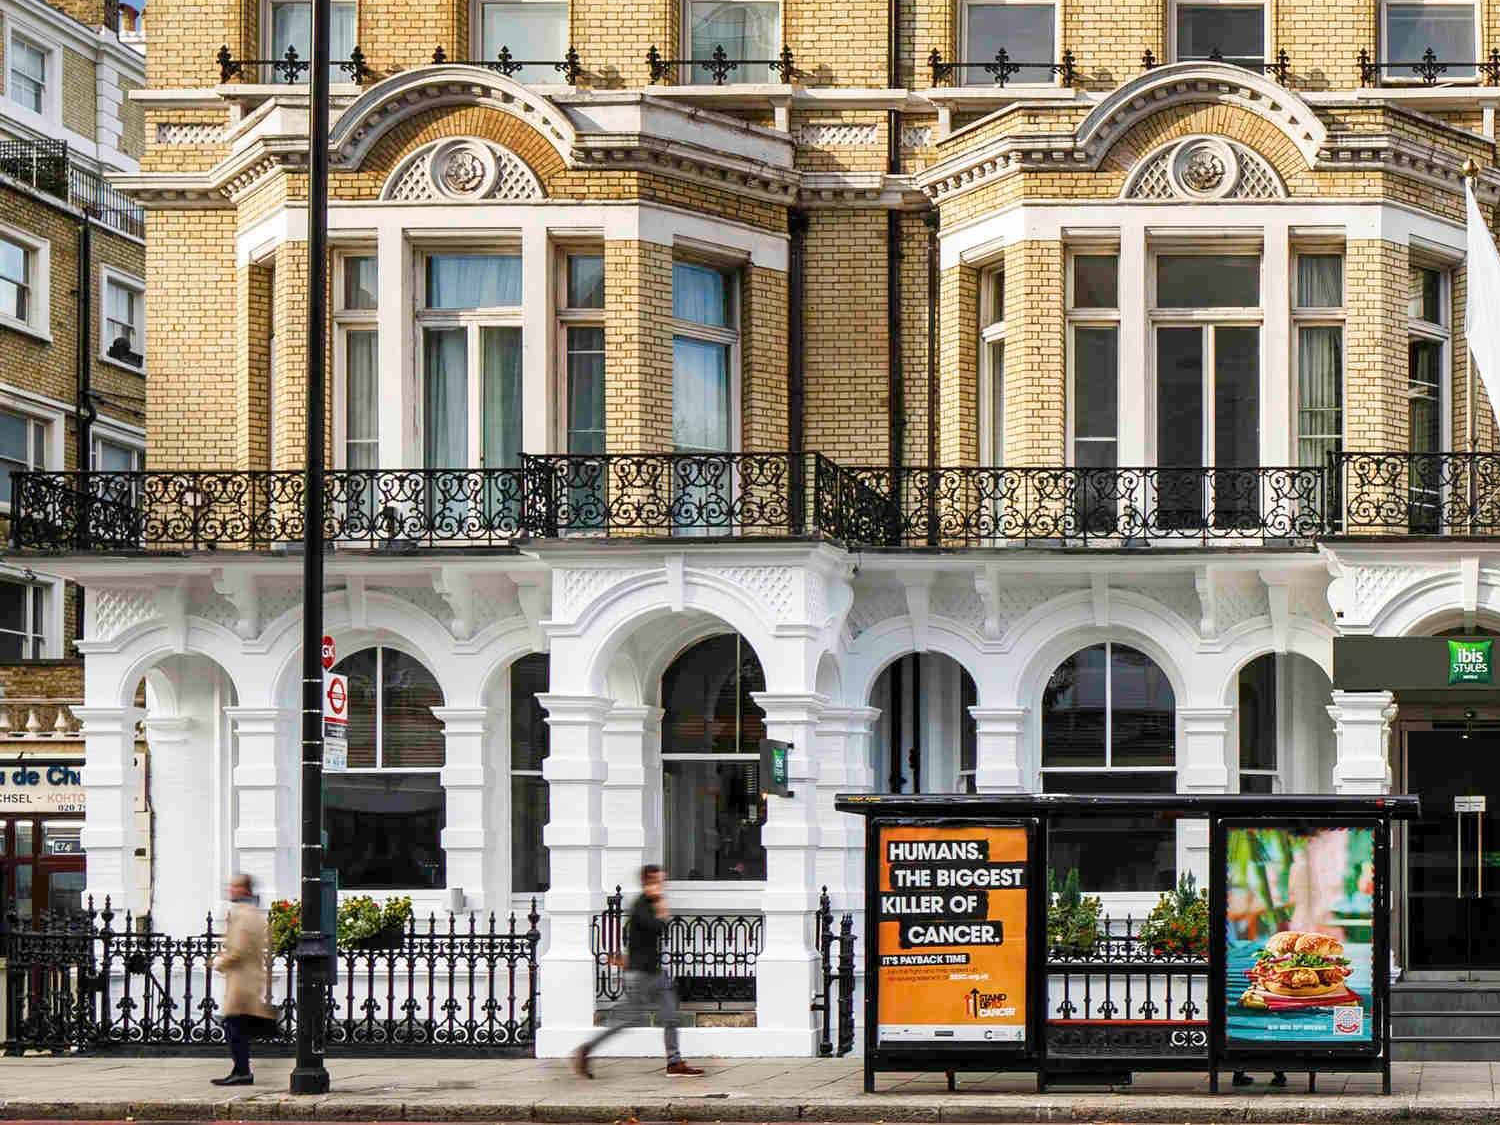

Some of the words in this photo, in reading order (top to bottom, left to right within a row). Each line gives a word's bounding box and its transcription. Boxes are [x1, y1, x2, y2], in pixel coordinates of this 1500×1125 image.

[1457, 648, 1484, 663] ibis
[12, 765, 40, 786] de
[889, 842, 984, 861] HUMANS.
[894, 869, 931, 887] THE
[936, 868, 1024, 887] BIGGEST
[881, 895, 944, 914] KILLER
[950, 895, 977, 914] OF
[907, 925, 1000, 944] CANCER.
[882, 955, 898, 965] IT'S
[900, 954, 943, 965] PAYBACK
[945, 954, 967, 963] TIME
[979, 993, 1007, 1003] STAND
[979, 1001, 991, 1009] UP
